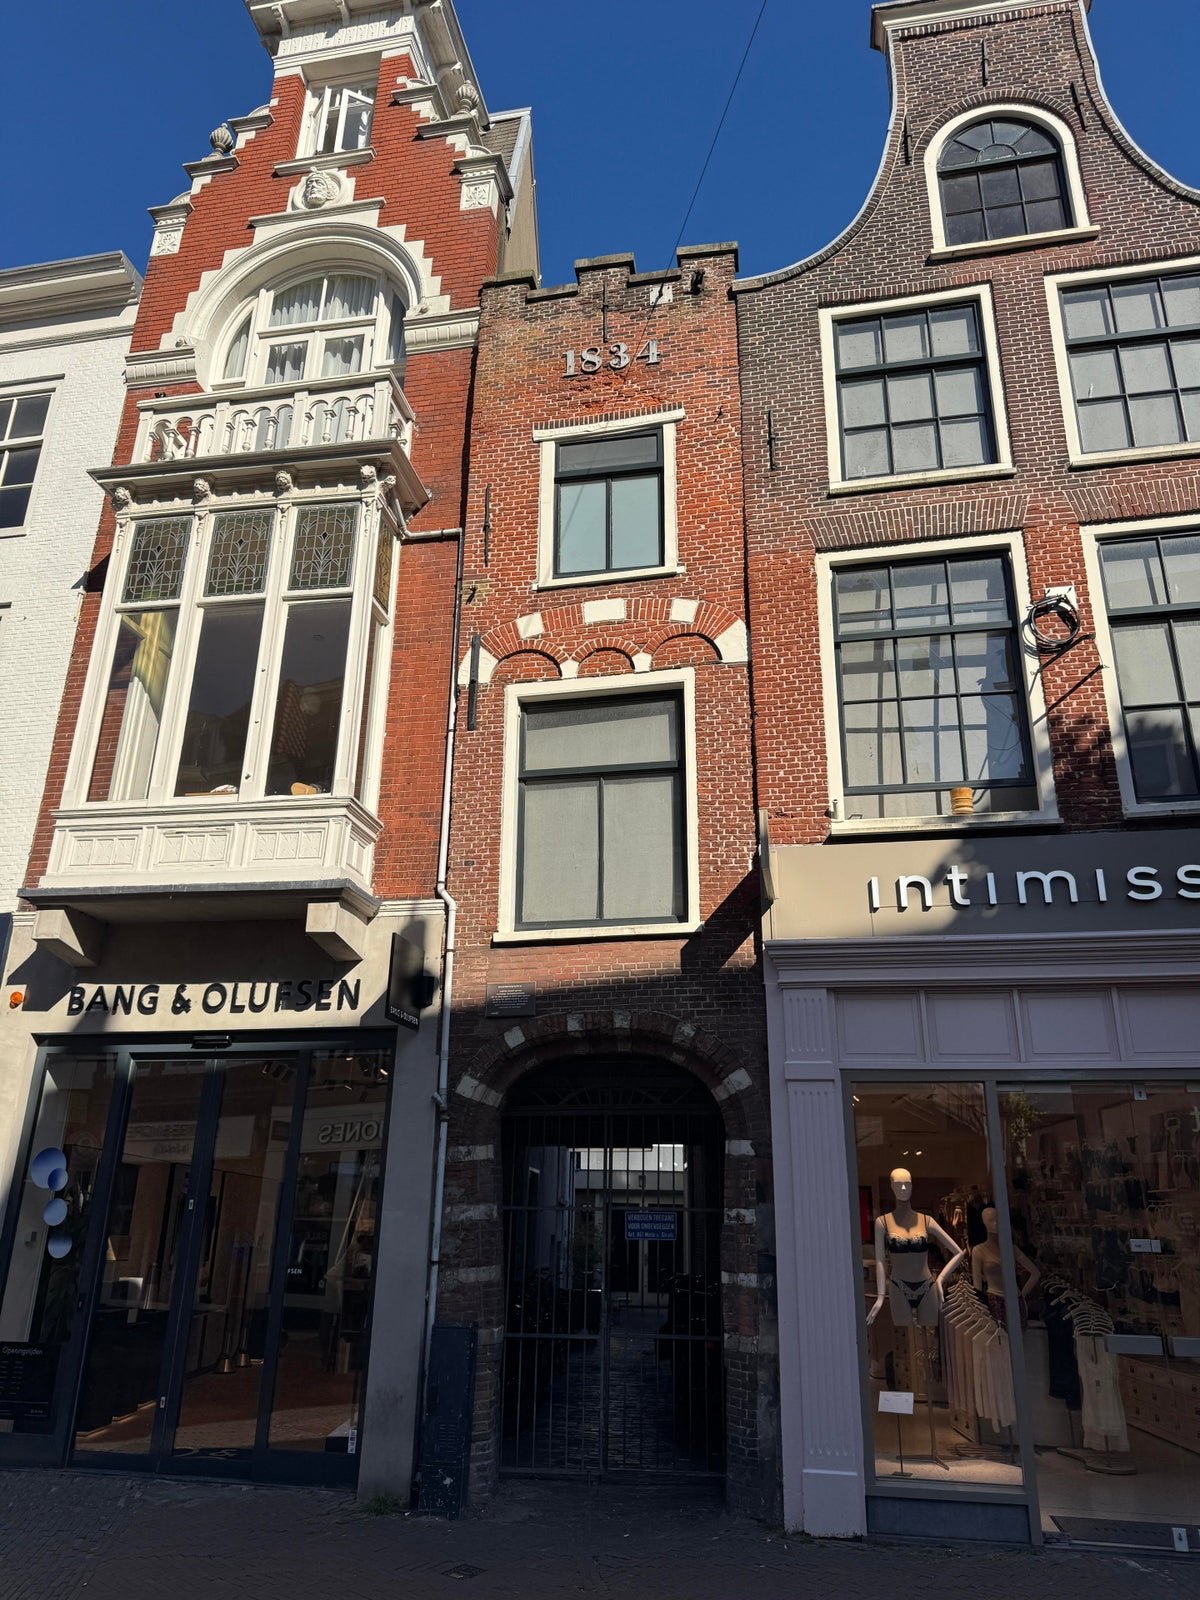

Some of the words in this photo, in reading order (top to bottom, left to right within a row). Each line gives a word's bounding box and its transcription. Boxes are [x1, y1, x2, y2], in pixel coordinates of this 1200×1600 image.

[561, 339, 661, 378] 1834
[66, 986, 159, 1016] BANG
[171, 984, 192, 1015] &
[202, 979, 361, 1014] OLUFSEN
